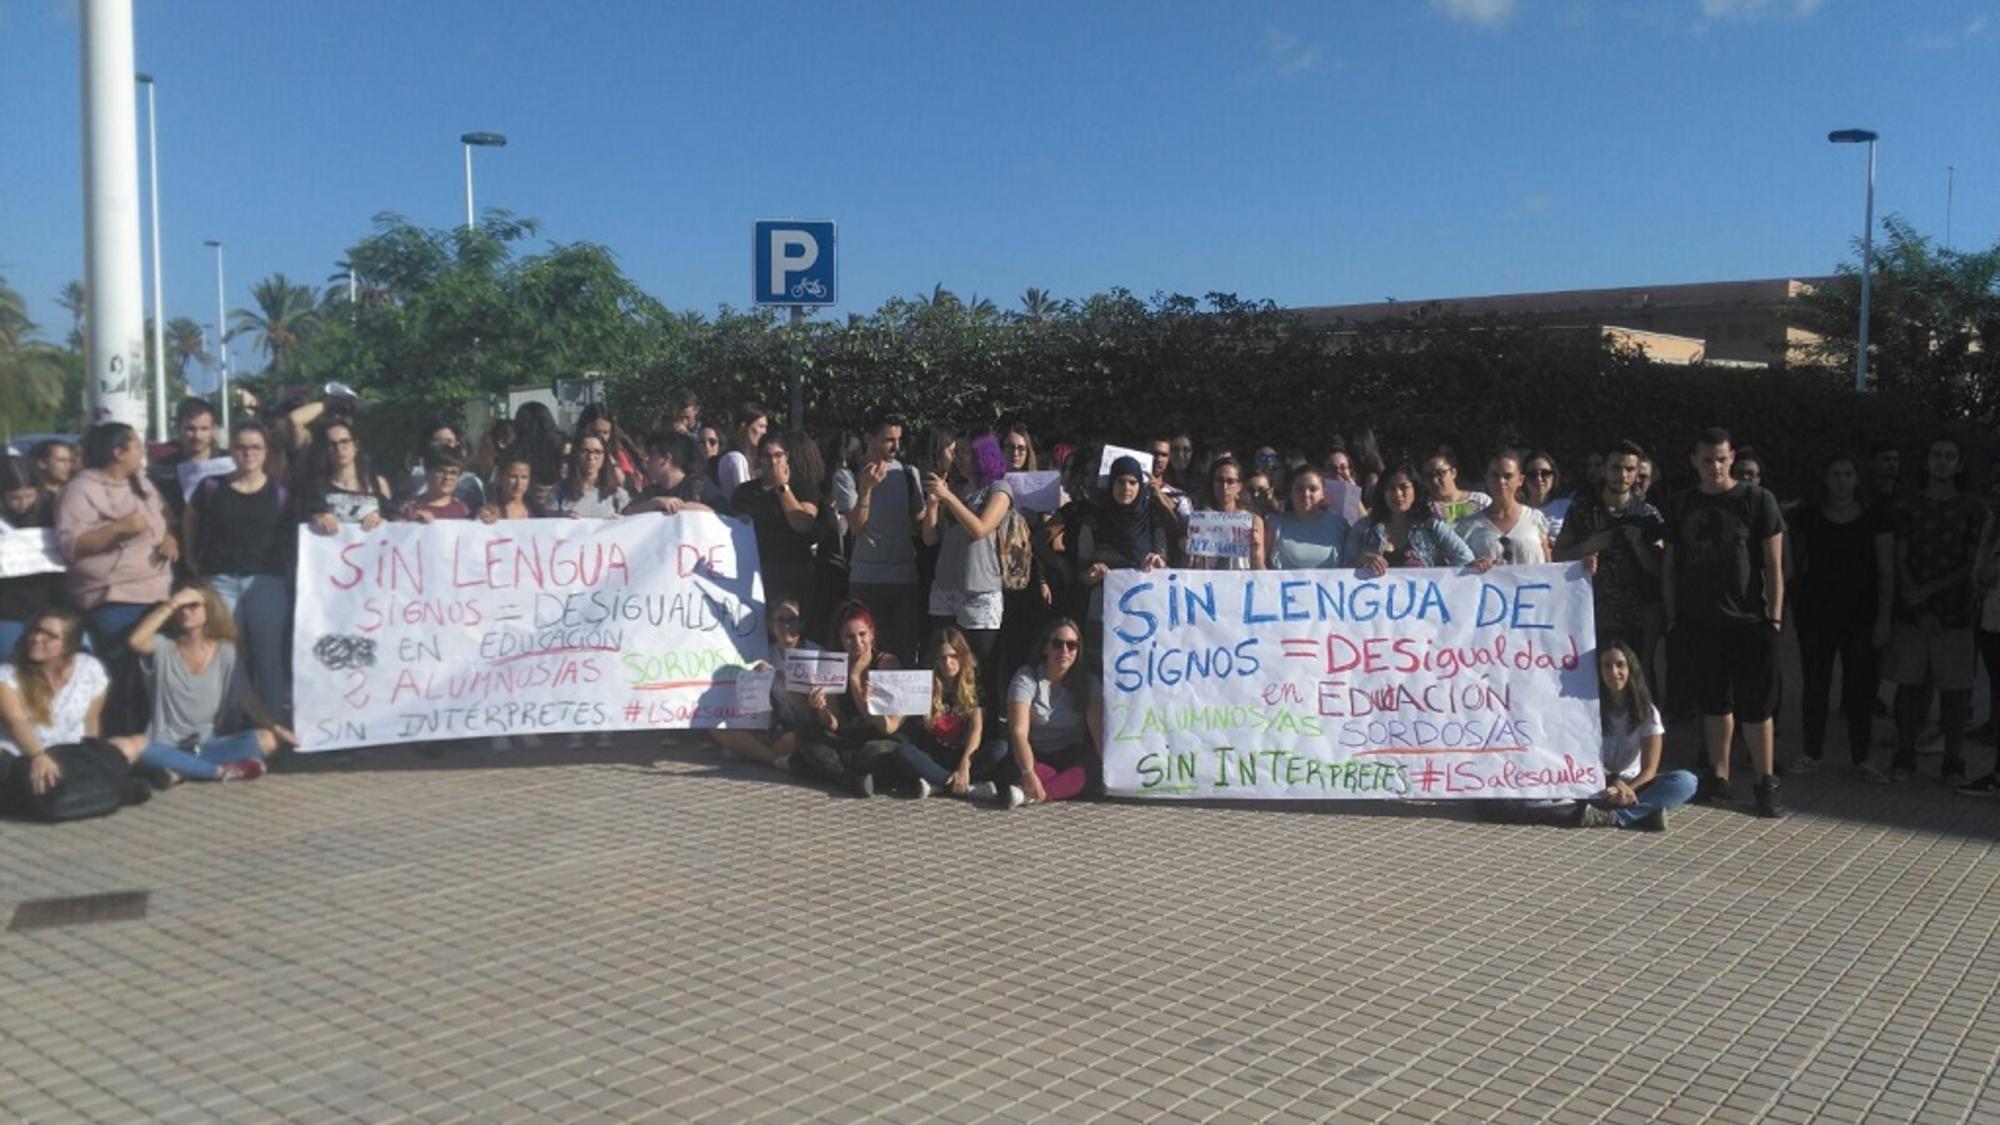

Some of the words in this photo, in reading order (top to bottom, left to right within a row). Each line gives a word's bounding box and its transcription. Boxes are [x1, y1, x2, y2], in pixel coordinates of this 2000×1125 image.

[771, 230, 819, 295] P
[453, 536, 629, 589] LENGUA
[677, 544, 726, 579] DE
[1243, 579, 1452, 626] LENGUA
[1476, 584, 1553, 629] DE
[399, 635, 441, 662] EN
[1326, 633, 1579, 680] DESigualdad
[391, 656, 601, 705] ALUMNOS/AS
[1261, 682, 1303, 706] en
[316, 718, 366, 746] SIN
[1339, 714, 1533, 750] SORDOS/AS
[1213, 747, 1409, 794] INTERPRETES
